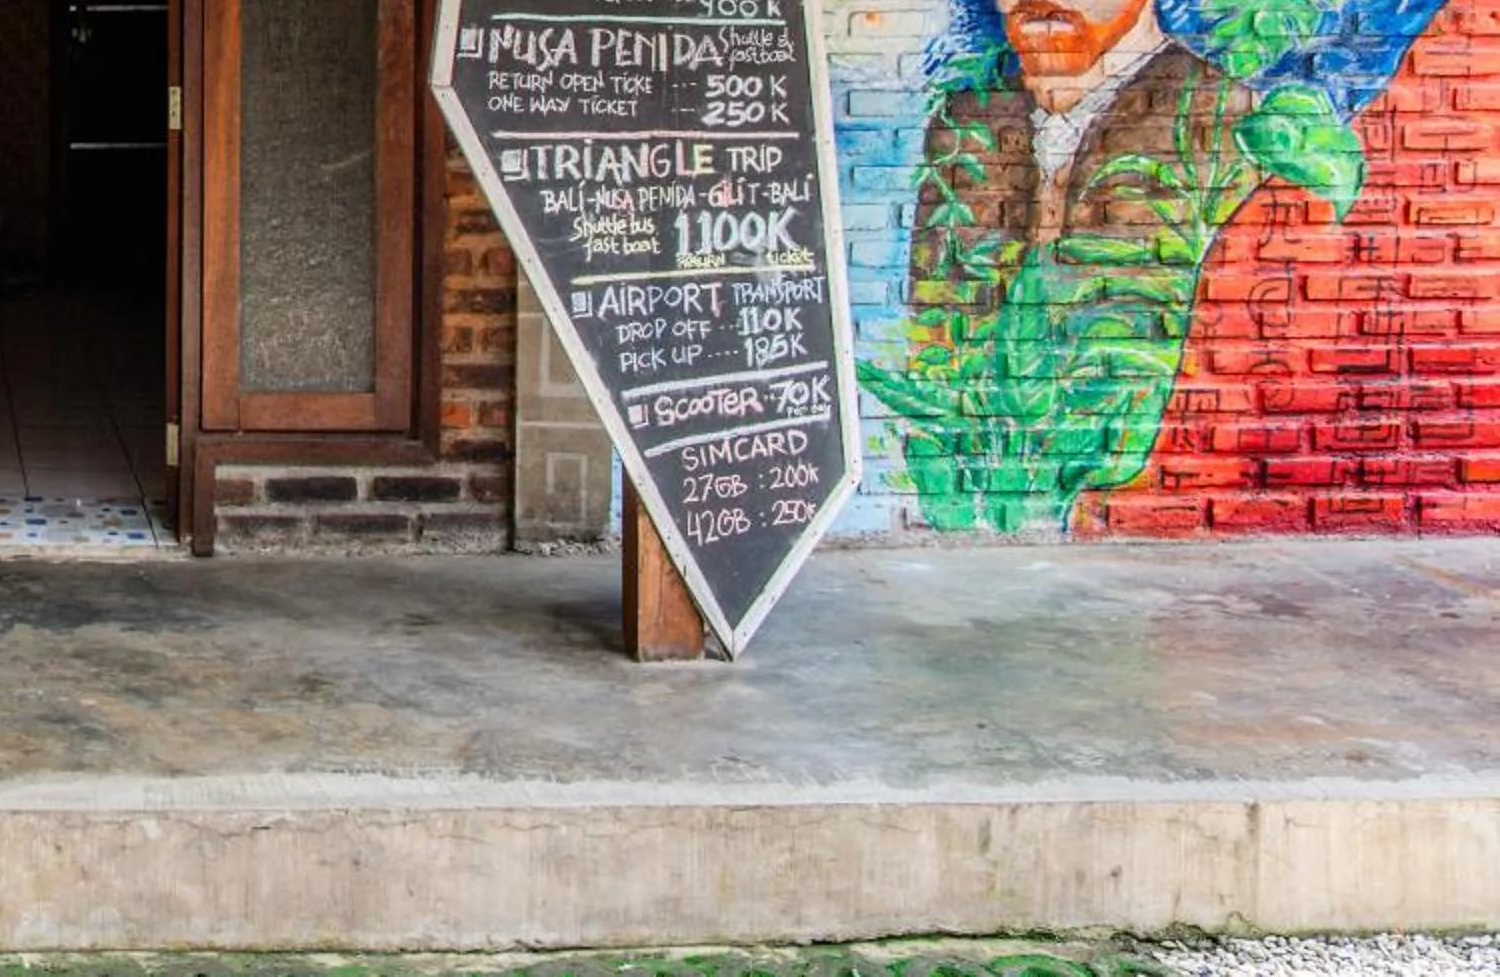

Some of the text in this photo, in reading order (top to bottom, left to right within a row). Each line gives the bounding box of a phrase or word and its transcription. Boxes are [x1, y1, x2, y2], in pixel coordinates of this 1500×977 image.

[488, 24, 578, 71] NUSA
[488, 71, 553, 92] RETURN
[559, 72, 604, 93] OPEN
[488, 93, 524, 112] ONE
[530, 95, 570, 115] WAY
[583, 236, 621, 263] fast
[615, 318, 668, 344] DROP
[671, 319, 712, 341] OFF
[671, 344, 703, 366] UP
[681, 429, 809, 472] SIMCARD
[682, 473, 749, 504] 27GB
[686, 507, 751, 547] 42GB
